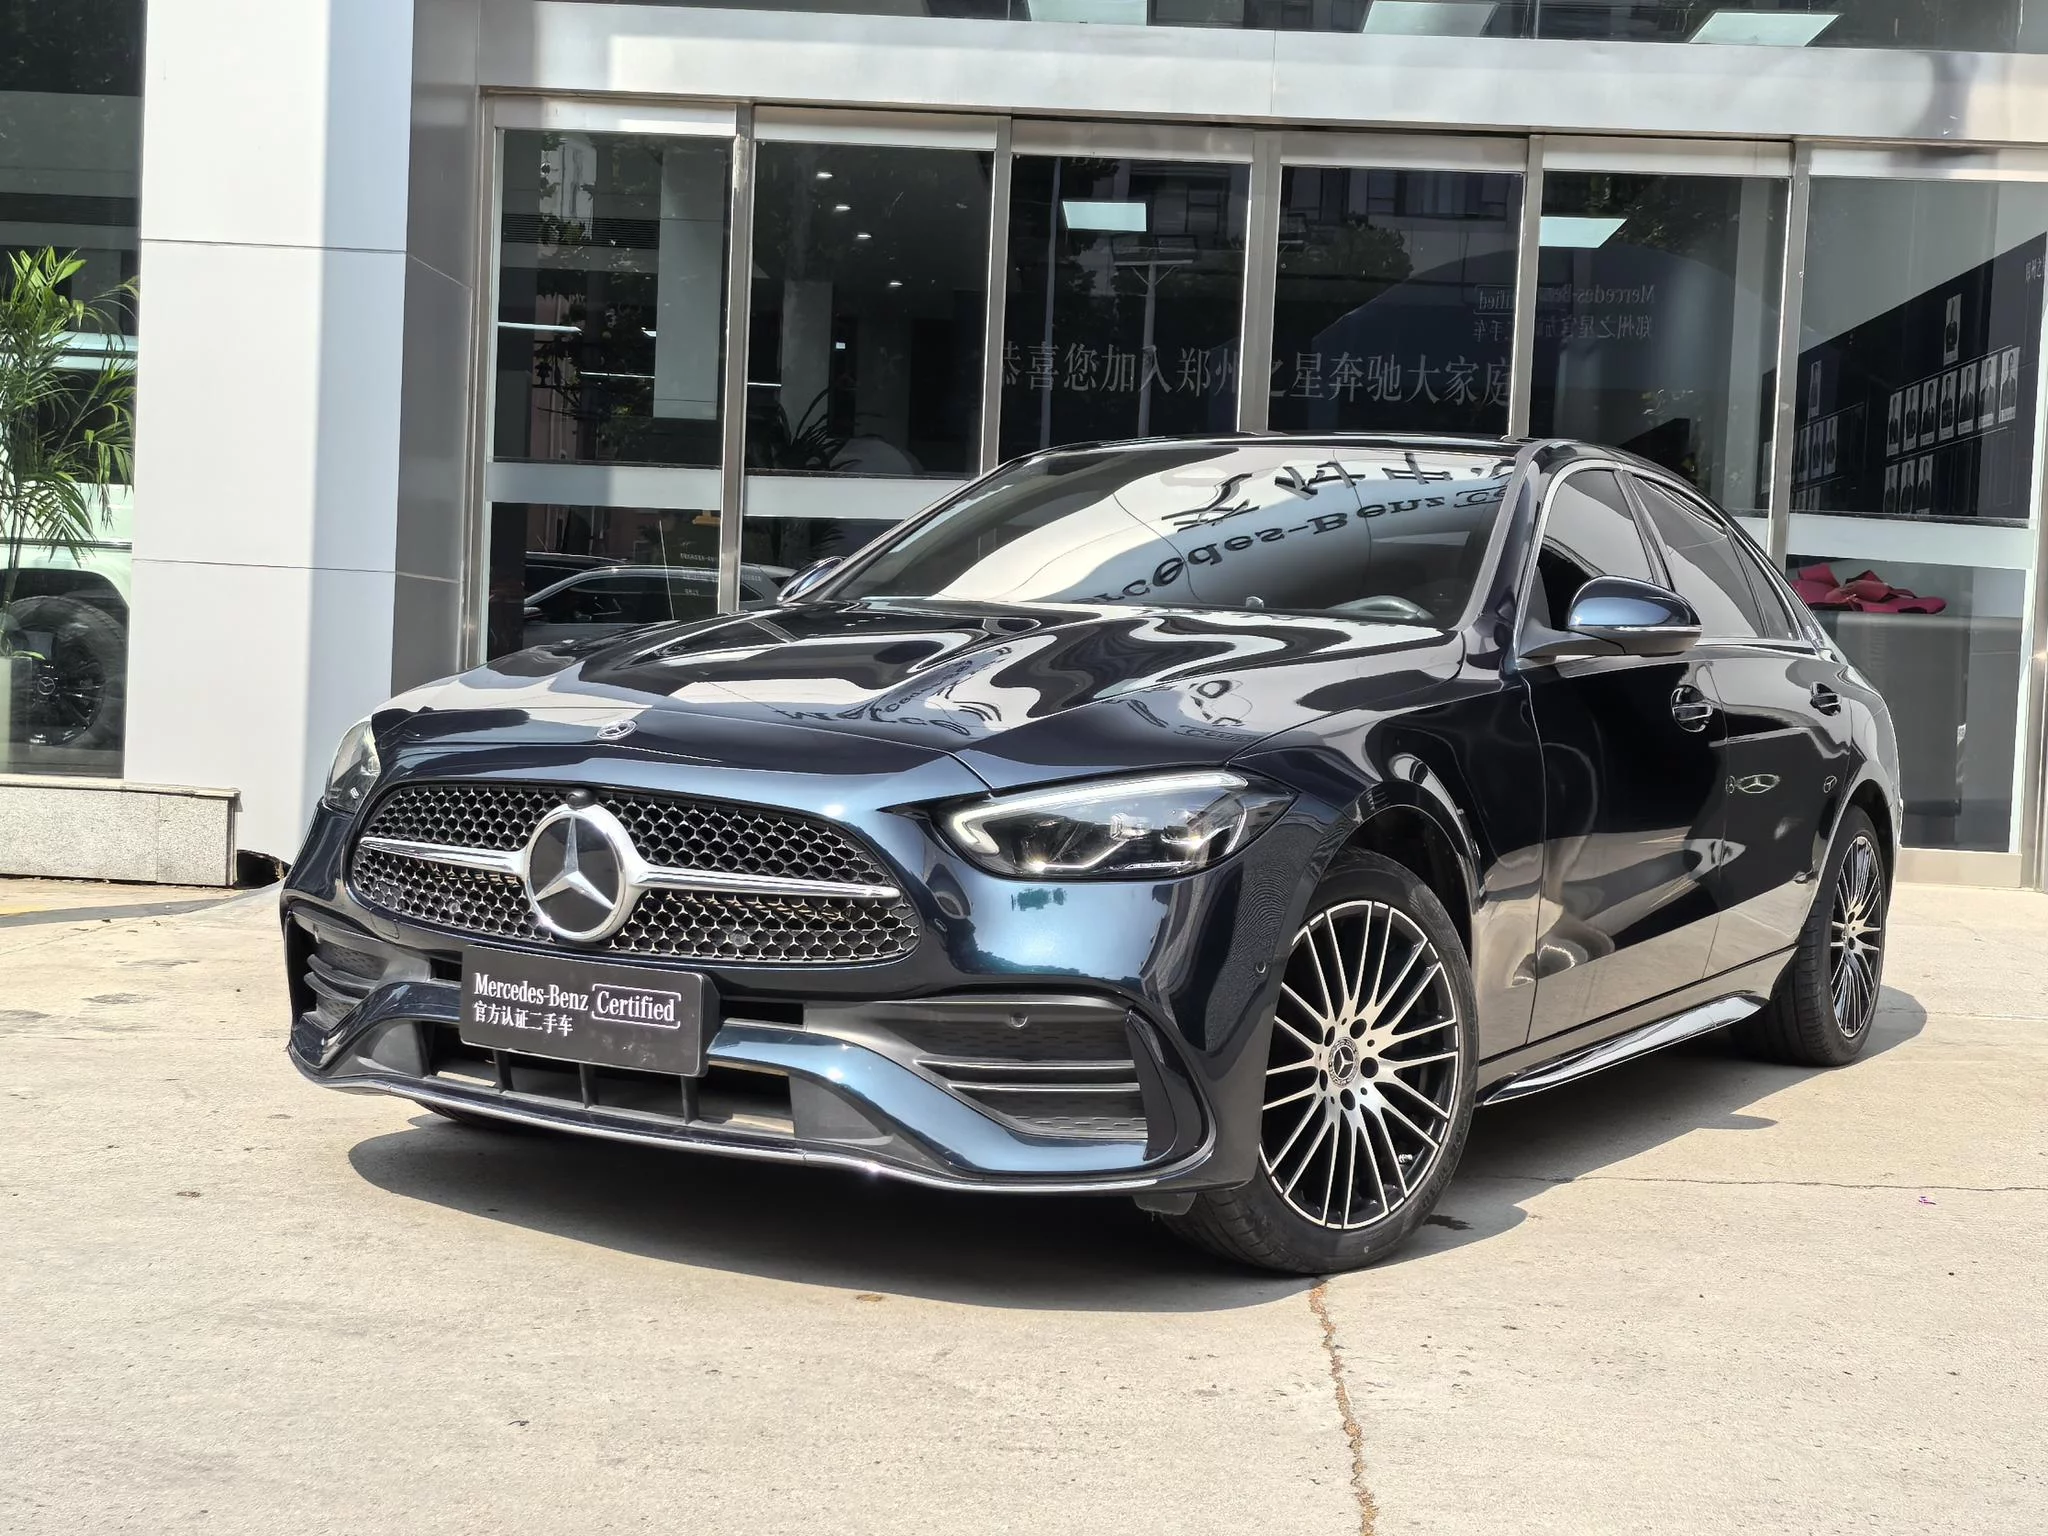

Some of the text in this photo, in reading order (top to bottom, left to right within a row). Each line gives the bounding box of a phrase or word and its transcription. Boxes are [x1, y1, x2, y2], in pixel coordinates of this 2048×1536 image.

[473, 999, 574, 1037] 官方认证二手车
[474, 972, 676, 1022] Mercedes-Benz Certified
